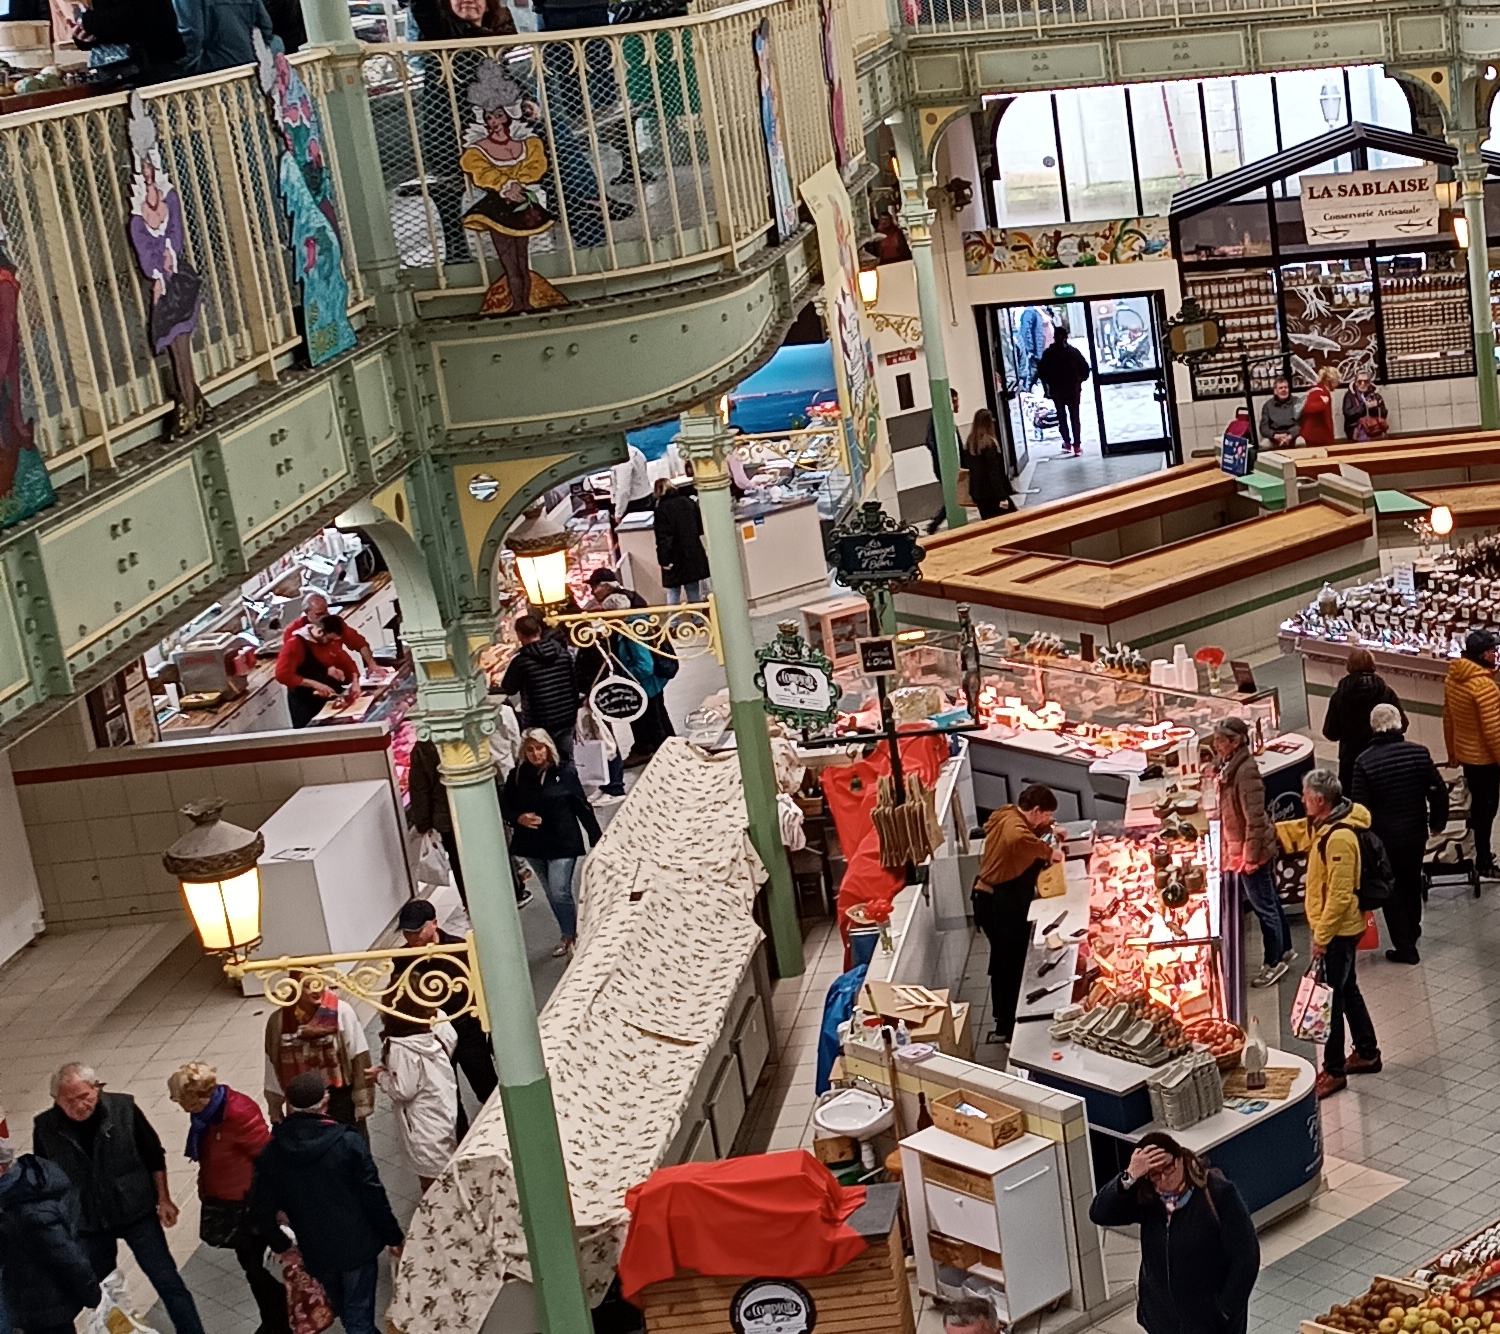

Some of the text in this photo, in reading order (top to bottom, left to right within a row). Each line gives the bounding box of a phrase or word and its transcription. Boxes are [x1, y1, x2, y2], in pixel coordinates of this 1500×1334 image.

[1308, 177, 1430, 200] LA SABLAISE
[1323, 205, 1421, 222] Conserverie Artisanale
